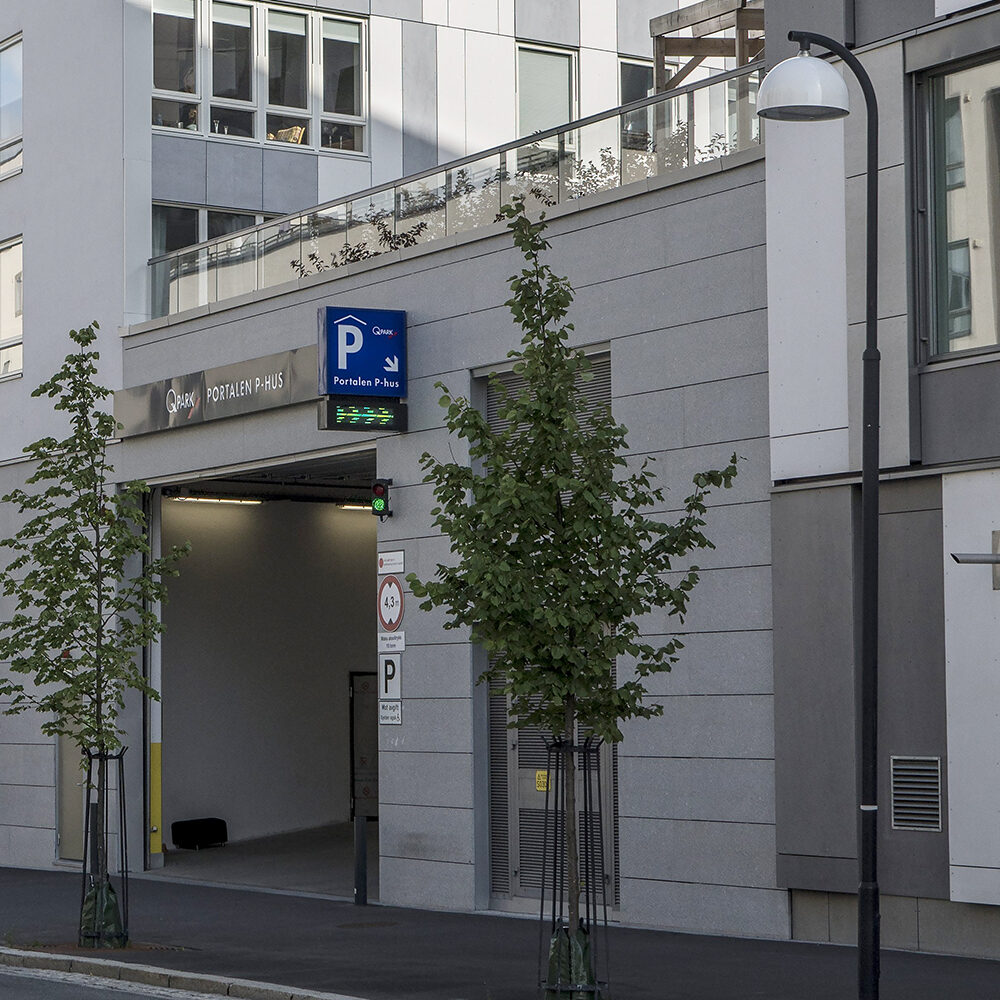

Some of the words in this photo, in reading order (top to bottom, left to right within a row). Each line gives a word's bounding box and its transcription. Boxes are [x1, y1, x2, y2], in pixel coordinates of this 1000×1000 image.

[338, 324, 364, 370] P
[207, 379, 252, 403] PORTALEN
[255, 372, 284, 393] P-HUS
[333, 376, 372, 387] Portalen
[374, 378, 400, 388] P-hus
[384, 596, 395, 610] 4,3
[384, 659, 396, 694] P
